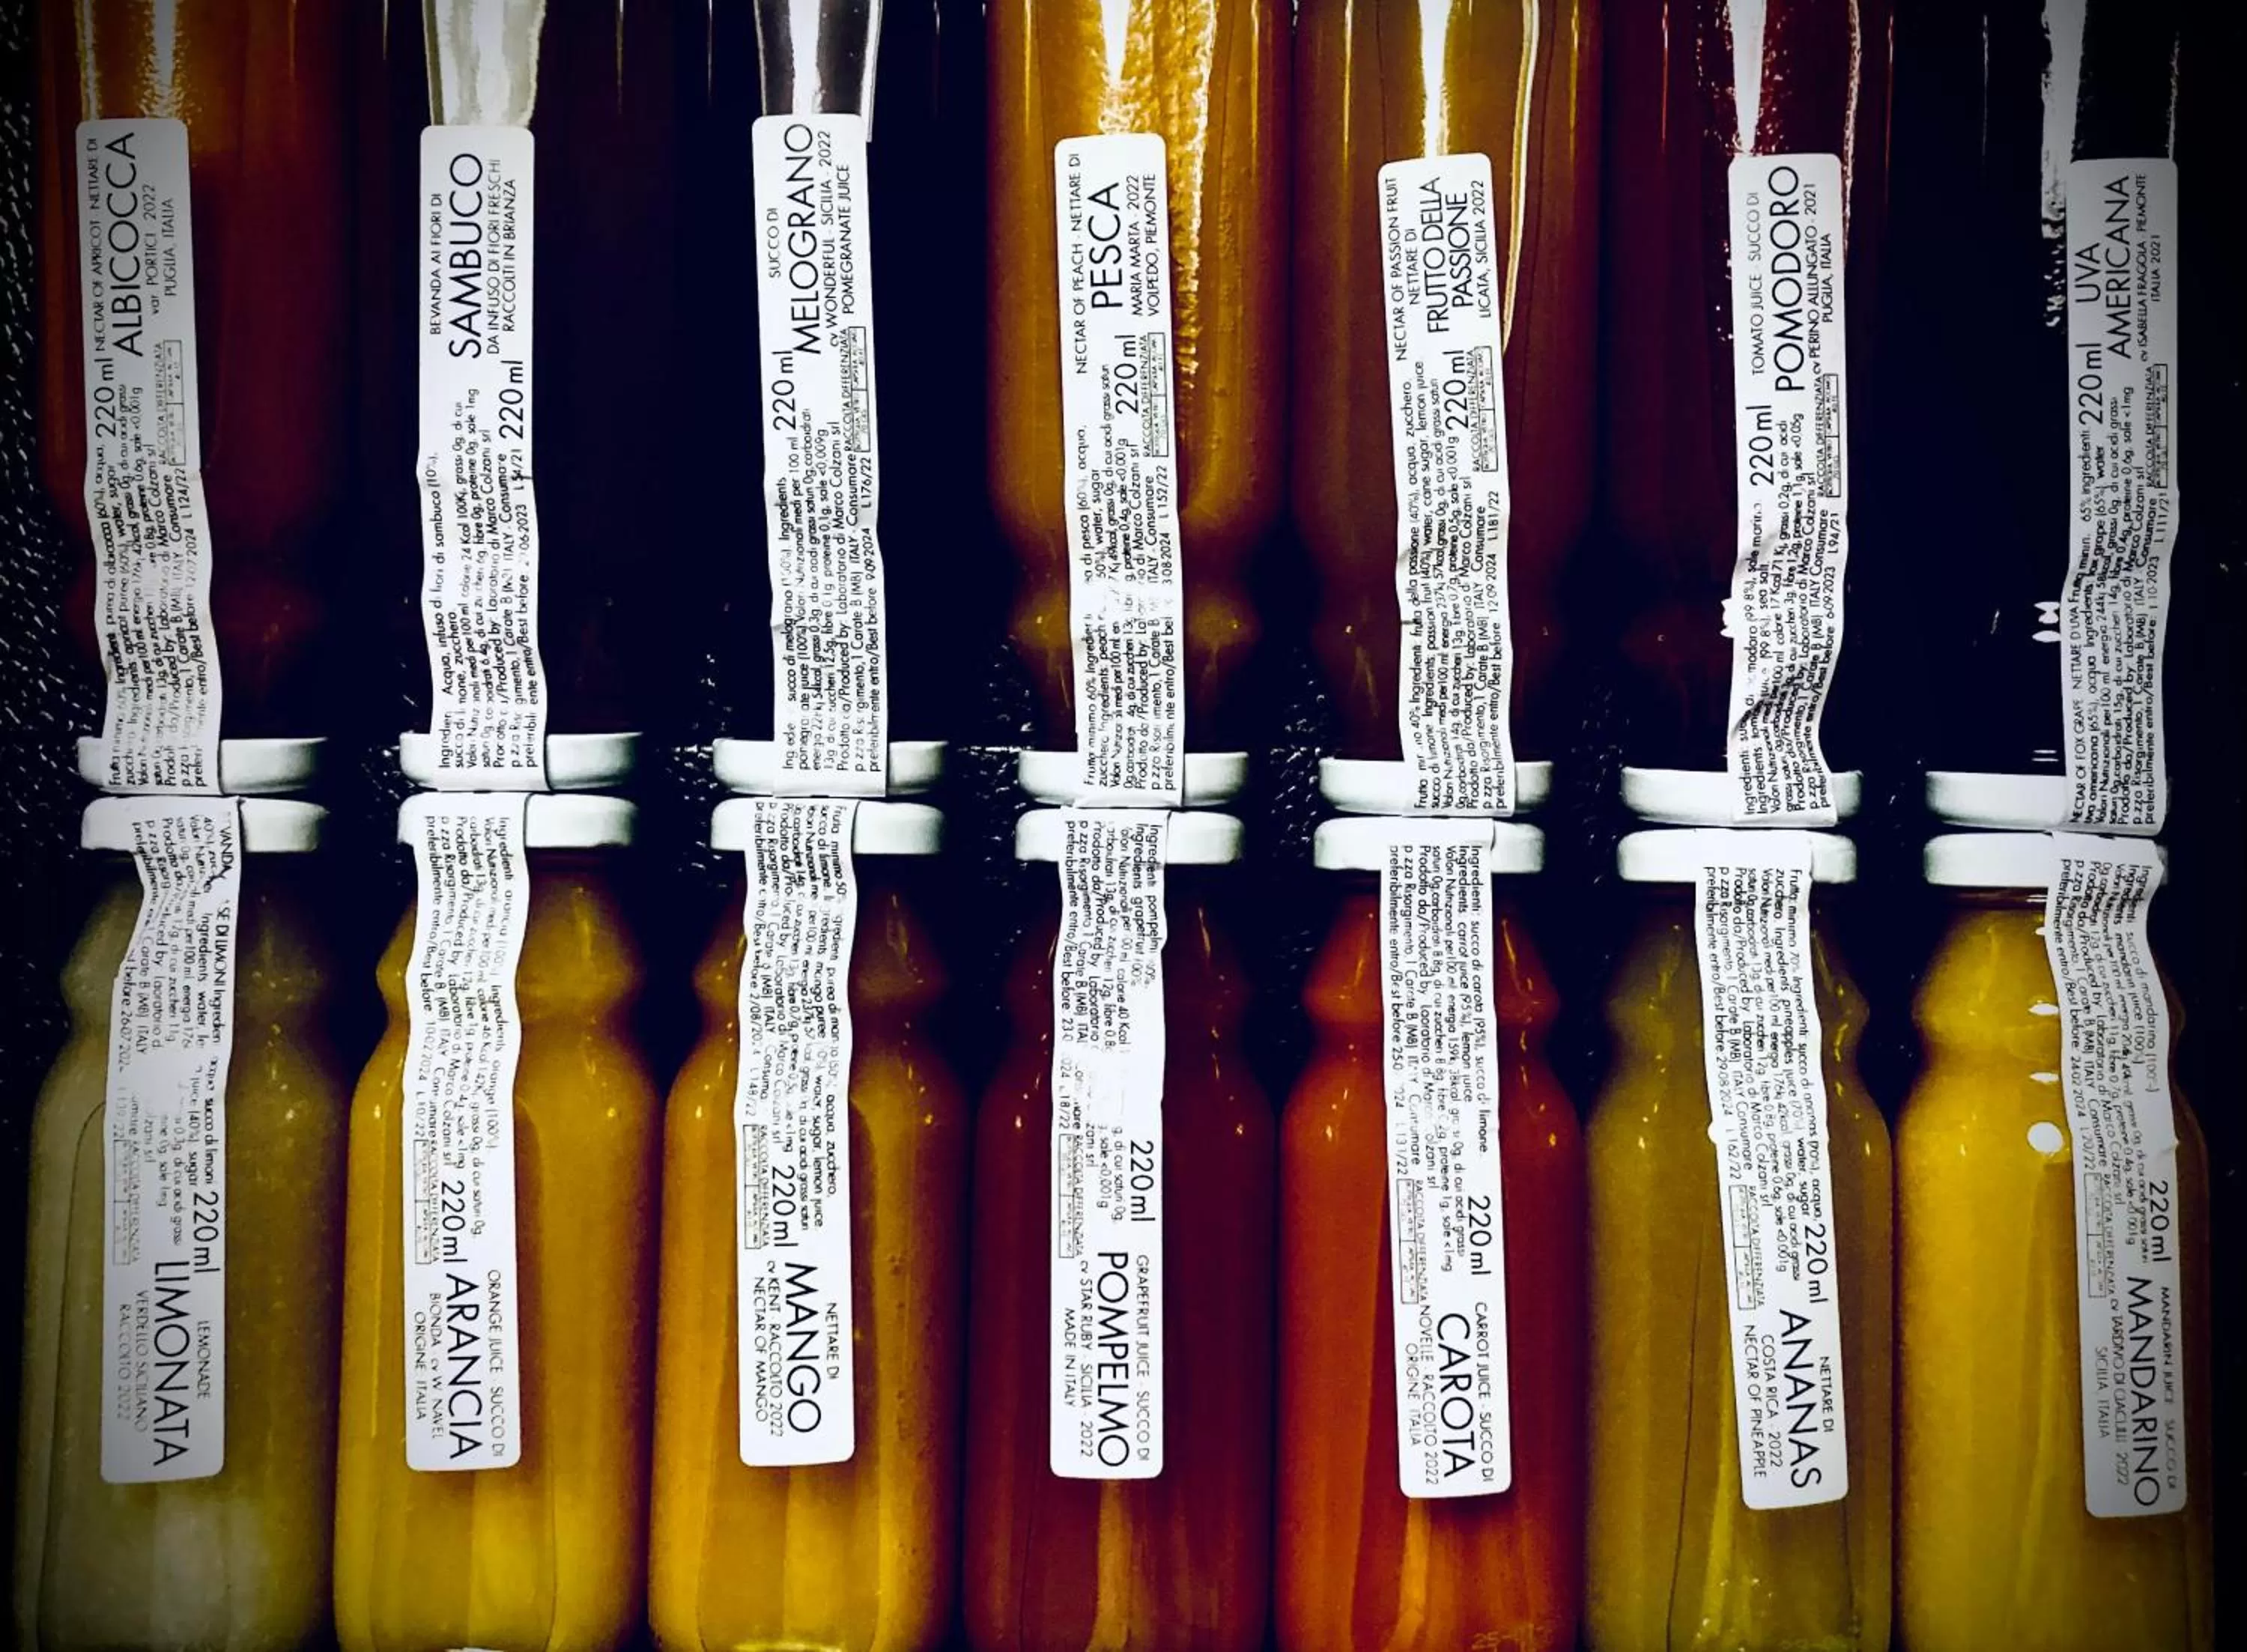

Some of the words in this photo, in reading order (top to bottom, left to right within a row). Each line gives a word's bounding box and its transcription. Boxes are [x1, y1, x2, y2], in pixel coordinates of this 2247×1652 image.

[86, 138, 99, 153] DI
[817, 130, 832, 167] 2022
[1068, 154, 1081, 167] DI
[87, 155, 101, 210] NETTARE
[142, 183, 157, 221] 2022
[430, 193, 443, 207] DI
[488, 160, 501, 215] FRESCHI
[820, 179, 834, 225] SICILIA
[836, 165, 852, 202] JUICE
[1069, 172, 1082, 231] NETTARE
[1126, 174, 1140, 210] 2022
[1385, 178, 1398, 213] FRUIT
[1470, 180, 1485, 215] 2022
[1746, 192, 1759, 206] DI
[1803, 183, 1817, 216] 2021
[2134, 172, 2148, 233] PIEMONTE
[161, 198, 175, 238] ITALIA
[430, 211, 443, 246] FIORI
[503, 179, 516, 240] BRIANZA
[766, 207, 778, 222] DI
[1142, 174, 1157, 244] PIEMONTE
[1404, 228, 1418, 242] DI
[1419, 177, 1445, 242] DELLA
[1746, 209, 1762, 261] SUCCO
[88, 219, 104, 276] APRICOT
[103, 132, 144, 357] ALBICOCCA
[144, 233, 160, 285] PORTICI
[430, 250, 441, 264] AI
[448, 153, 483, 359] SAMBUCO
[487, 219, 501, 255] FIORI
[503, 243, 515, 261] IN
[767, 225, 781, 279] SUCCO
[782, 124, 822, 355] MELOGRANO
[837, 206, 855, 315] POMEGRANATE
[1087, 182, 1124, 309] PESCA
[1127, 221, 1141, 268] MARTA
[1388, 216, 1402, 278] PASSION
[1443, 190, 1476, 308] PASSIONE
[1474, 219, 1488, 264] SICILIA
[1819, 233, 1832, 270] ITALIA
[2148, 234, 2162, 264] 2021
[91, 280, 105, 298] OF
[487, 258, 500, 272] DI
[822, 237, 838, 329] WONDERFUL
[1071, 243, 1085, 291] PEACH
[1145, 248, 1160, 317] VOLPEDO,
[1405, 247, 1421, 306] NETTARE
[1422, 246, 1450, 333] FRUTTO
[1767, 165, 1806, 392] POMODORO
[1804, 225, 1819, 306] ALLUNGATO
[2073, 242, 2102, 303] UVA
[2103, 174, 2132, 359] AMERICANA
[2135, 240, 2148, 297] FRAGOLA
[2150, 267, 2161, 303] ITALIA
[429, 268, 443, 335] BEVANDA
[486, 276, 501, 330] INFUSO
[501, 264, 516, 332] RACCOLTI
[1073, 298, 1086, 315] OF
[1129, 272, 1143, 317] MARIA
[1391, 284, 1404, 303] OF
[1476, 268, 1491, 318] LICATA,
[1749, 274, 1764, 311] JUICE
[92, 300, 106, 352] NECTAR
[486, 335, 500, 354] DA
[1073, 319, 1088, 374] NECTAR
[1392, 306, 1407, 362] NECTAR
[1750, 314, 1765, 376] TOMATO
[1807, 309, 1821, 359] PERINO
[2136, 298, 2149, 349] ISABELLA
[1114, 362, 1139, 415] 220
[1415, 362, 1429, 389] juice
[94, 386, 118, 438] 220
[771, 380, 796, 431] 220
[1414, 393, 1428, 431] lemon
[163, 475, 182, 543] Consumare
[832, 491, 844, 529] Marco
[846, 454, 858, 526] Consumare
[1144, 475, 1156, 546] Consumare
[431, 491, 446, 547] sambuco
[1811, 509, 1828, 577] Consumare
[2071, 644, 2083, 690] NETTARE
[2073, 737, 2085, 760] FOX
[2075, 763, 2086, 780] OF
[2070, 782, 2086, 824] NECTAR
[1780, 1000, 1795, 1064] pineapples
[2140, 982, 2157, 1049] mandarino
[1736, 1101, 1753, 1170] Consumare
[1467, 1195, 1493, 1247] 220
[429, 1293, 443, 1347] BIONDA
[488, 1269, 503, 1332] ORANGE
[753, 1277, 766, 1331] NECTAR
[768, 1277, 781, 1313] KENT
[1079, 1278, 1093, 1311] STAR
[1136, 1254, 1150, 1336] GRAPEFRUIT
[135, 1290, 149, 1356] VERDELLO
[414, 1311, 427, 1370] ORIGINE
[754, 1335, 767, 1354] OF
[784, 1262, 822, 1433] MANGO
[825, 1302, 840, 1361] NETTARE
[1064, 1308, 1076, 1348] MADE
[1080, 1315, 1093, 1350] RUBY
[1419, 1305, 1434, 1361] NOVELLE
[1475, 1302, 1490, 1358] CARROT
[2111, 1314, 2125, 1370] TARDIVO
[2160, 1286, 2174, 1367] MANDARIN
[153, 1260, 192, 1467] LIMONATA
[197, 1320, 211, 1399] LEMONADE
[446, 1272, 483, 1460] ARANCIA
[488, 1337, 503, 1373] JUICE
[768, 1323, 783, 1398] RACCOLTO
[826, 1366, 840, 1379] DI
[1064, 1355, 1076, 1370] IN
[1097, 1251, 1130, 1467] POMPELMO
[1135, 1340, 1150, 1377] JUICE
[1405, 1343, 1420, 1400] ORIGINE
[1744, 1325, 1759, 1379] NECTAR
[1761, 1334, 1777, 1382] COSTA
[2113, 1371, 2127, 1385] DI
[416, 1380, 428, 1420] ITALIA
[755, 1361, 768, 1422] MANGO
[1064, 1374, 1076, 1407] ITALY
[1080, 1363, 1094, 1408] SICILIA
[1437, 1313, 1476, 1478] CAROTA
[1476, 1362, 1491, 1399] JUICE
[1747, 1383, 1762, 1402] OF
[1765, 1386, 1780, 1419] RICA
[1777, 1308, 1822, 1488] ANANAS
[1819, 1356, 1834, 1414] NETTARE
[2125, 1276, 2161, 1507] MANDARINO
[490, 1386, 505, 1439] SUCCO
[769, 1403, 783, 1437] 2022
[1136, 1391, 1150, 1443] SUCCO
[1409, 1409, 1422, 1445] ITALIA
[1422, 1374, 1437, 1447] RACCOLTO
[1822, 1418, 1834, 1433] DI
[491, 1443, 506, 1457] DI
[1080, 1421, 1094, 1457] 2022
[1137, 1448, 1150, 1460] DI
[1479, 1412, 1494, 1464] SUCCO
[1750, 1409, 1767, 1478] PINEAPPLE
[1768, 1431, 1783, 1468] 2022
[1425, 1451, 1439, 1484] 2022
[1481, 1467, 1494, 1482] DI
[2115, 1452, 2129, 1486] 2022
